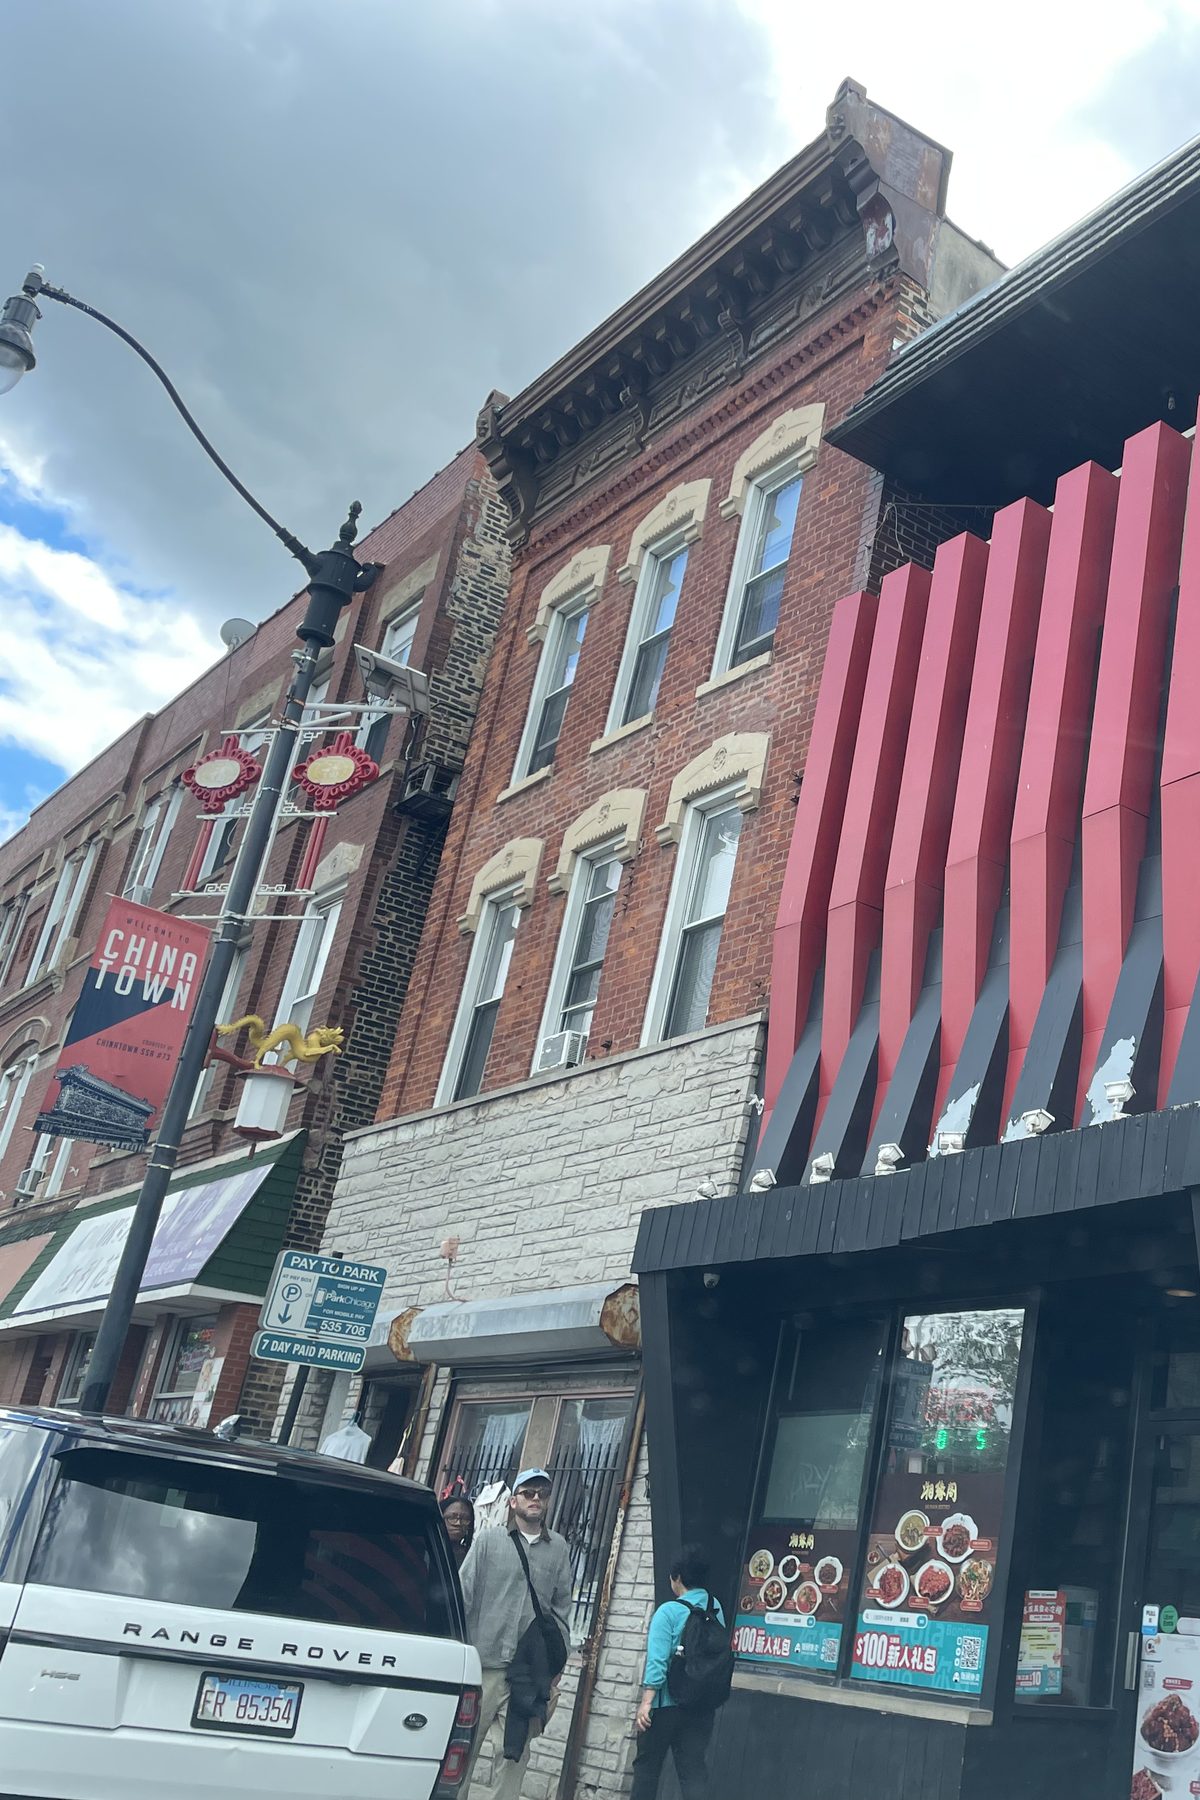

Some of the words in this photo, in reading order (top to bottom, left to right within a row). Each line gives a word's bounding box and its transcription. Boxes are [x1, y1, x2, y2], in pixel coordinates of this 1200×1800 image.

[126, 918, 173, 938] WELCOME
[179, 935, 190, 944] TO
[104, 929, 198, 981] CHINA
[95, 958, 191, 1011] TOWN
[96, 1038, 139, 1053] CHINATOWN
[290, 1256, 318, 1270] PAY
[321, 1261, 340, 1274] TO
[342, 1264, 380, 1282] PARK
[325, 1291, 376, 1309] ParkChicago
[320, 1320, 342, 1333] 535
[345, 1324, 366, 1336] 708
[261, 1339, 269, 1351] 7
[270, 1340, 290, 1354] DAY
[292, 1344, 316, 1357] PAID
[318, 1347, 362, 1365] PARKING
[123, 1623, 254, 1650] RANGE
[281, 1643, 397, 1667] ROVER
[236, 1694, 292, 1724] 85354
